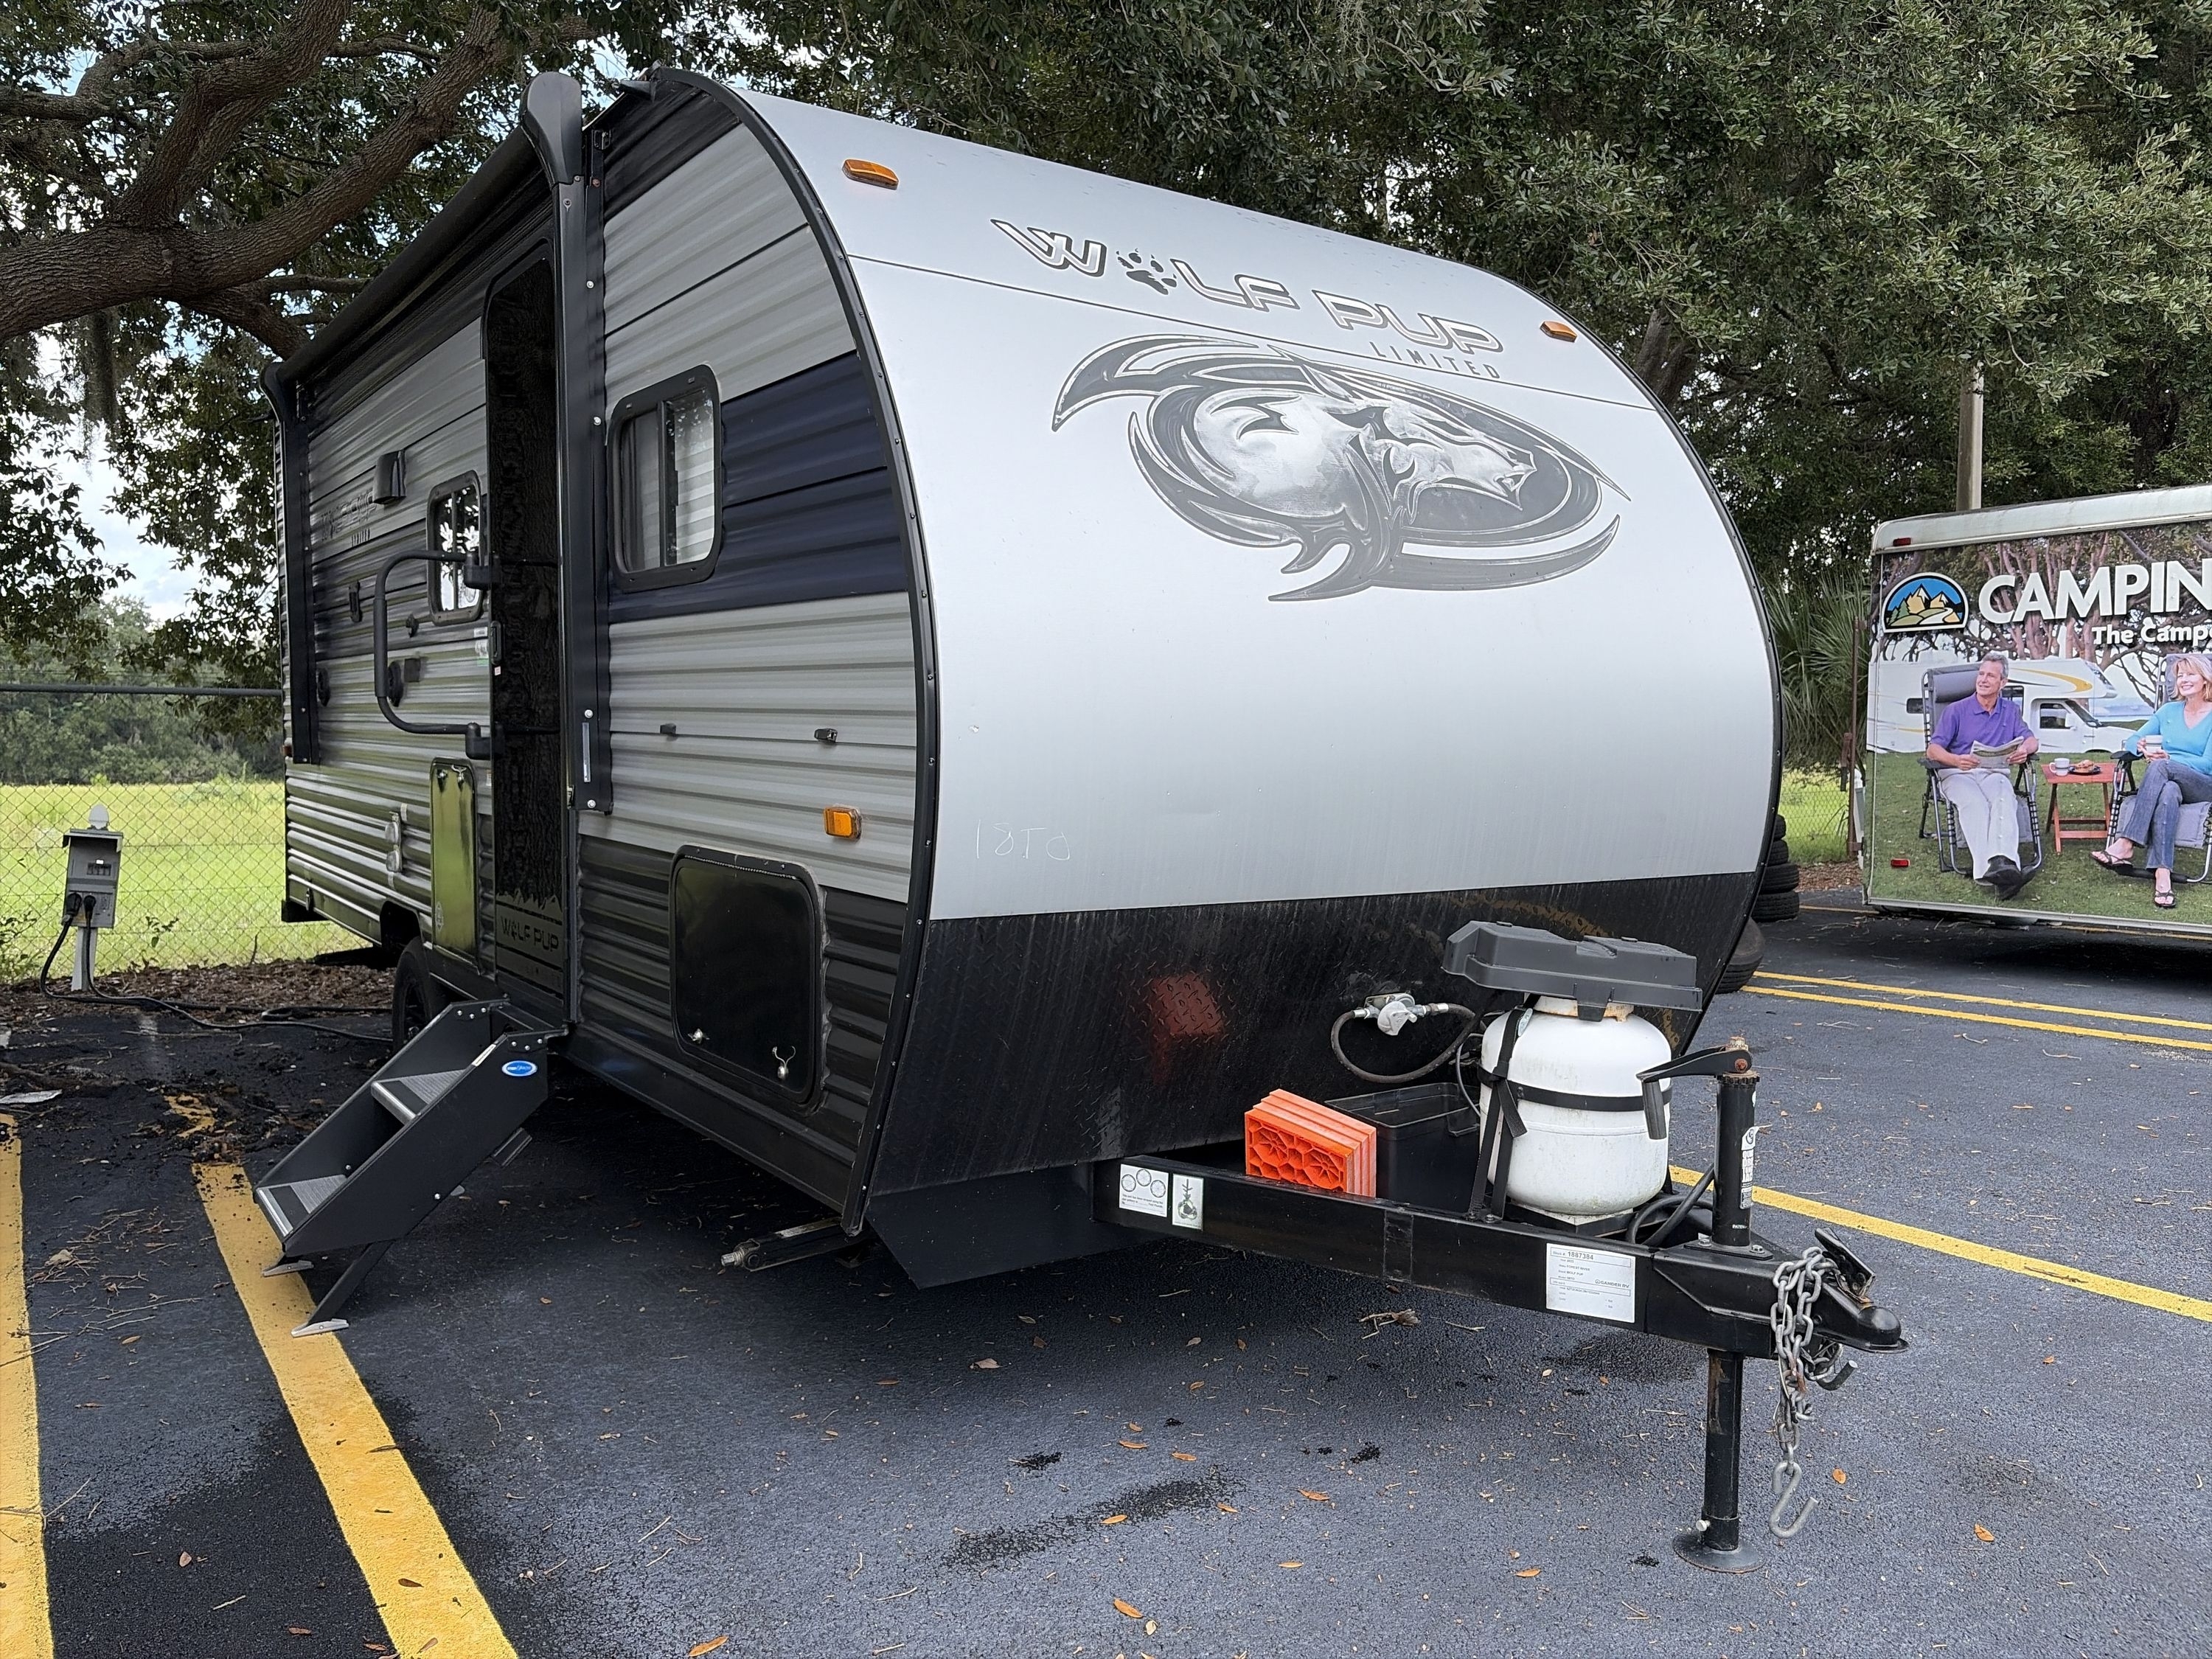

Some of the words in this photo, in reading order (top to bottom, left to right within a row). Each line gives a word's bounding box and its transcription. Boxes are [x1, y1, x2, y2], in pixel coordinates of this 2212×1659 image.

[990, 219, 1300, 312] WLF
[1312, 290, 1504, 353] PUP
[1368, 341, 1501, 380] LIMITED
[1978, 558, 2212, 625] CAMPIN
[2092, 625, 2135, 645] The
[533, 928, 559, 953] PUP
[1568, 1251, 1593, 1260] 1887384
